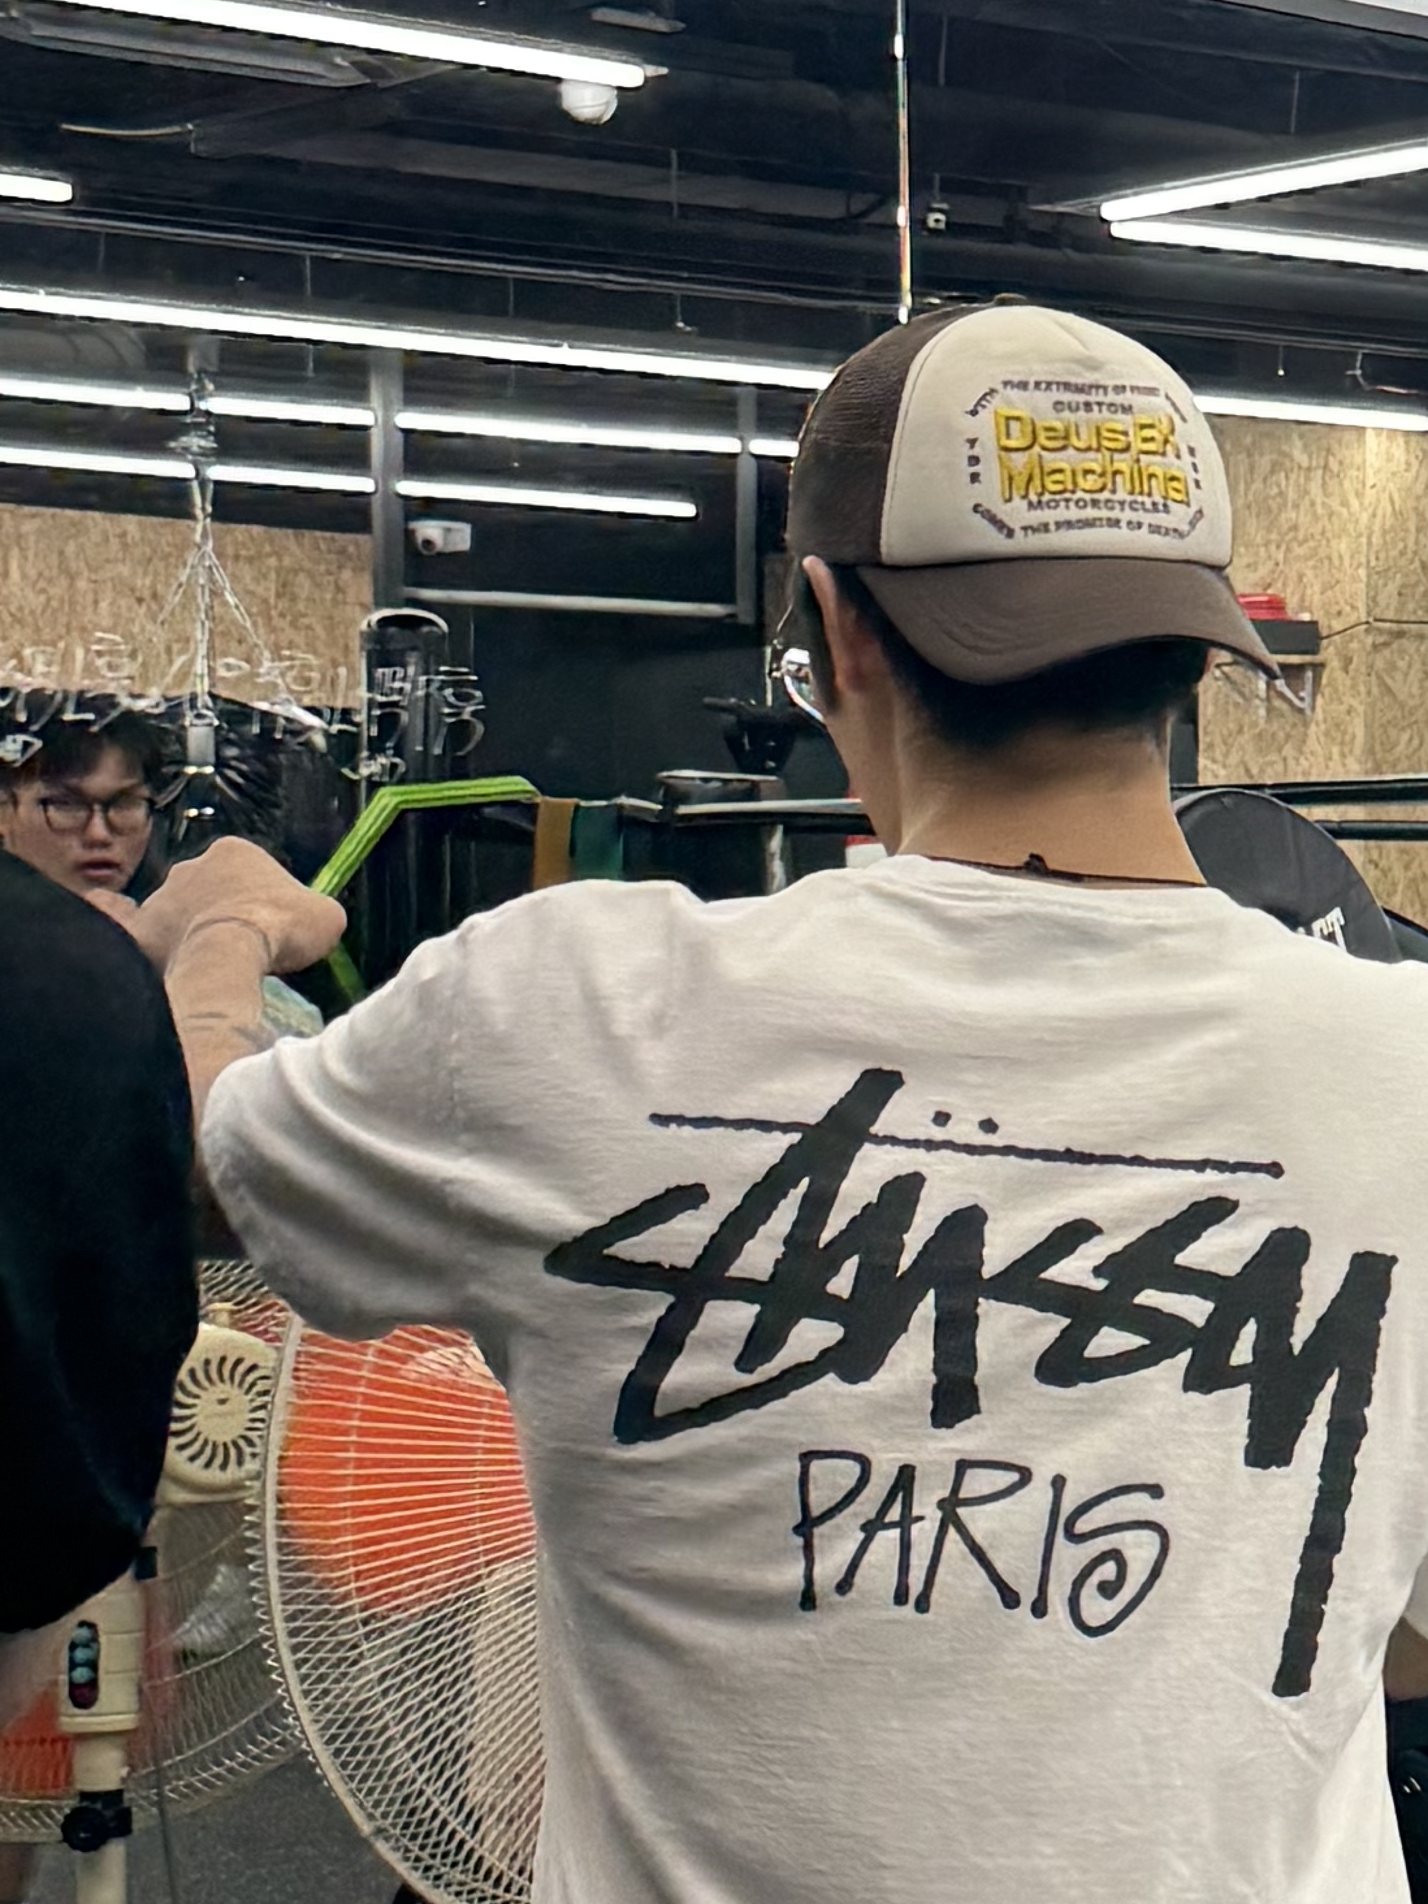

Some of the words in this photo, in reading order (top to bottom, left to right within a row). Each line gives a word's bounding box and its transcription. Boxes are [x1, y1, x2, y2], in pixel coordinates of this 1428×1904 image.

[1052, 400, 1134, 415] CUSTOM
[998, 457, 1191, 507] Machina
[1027, 497, 1171, 514] MOTORCYCLES
[793, 1449, 1169, 1637] PARIS
